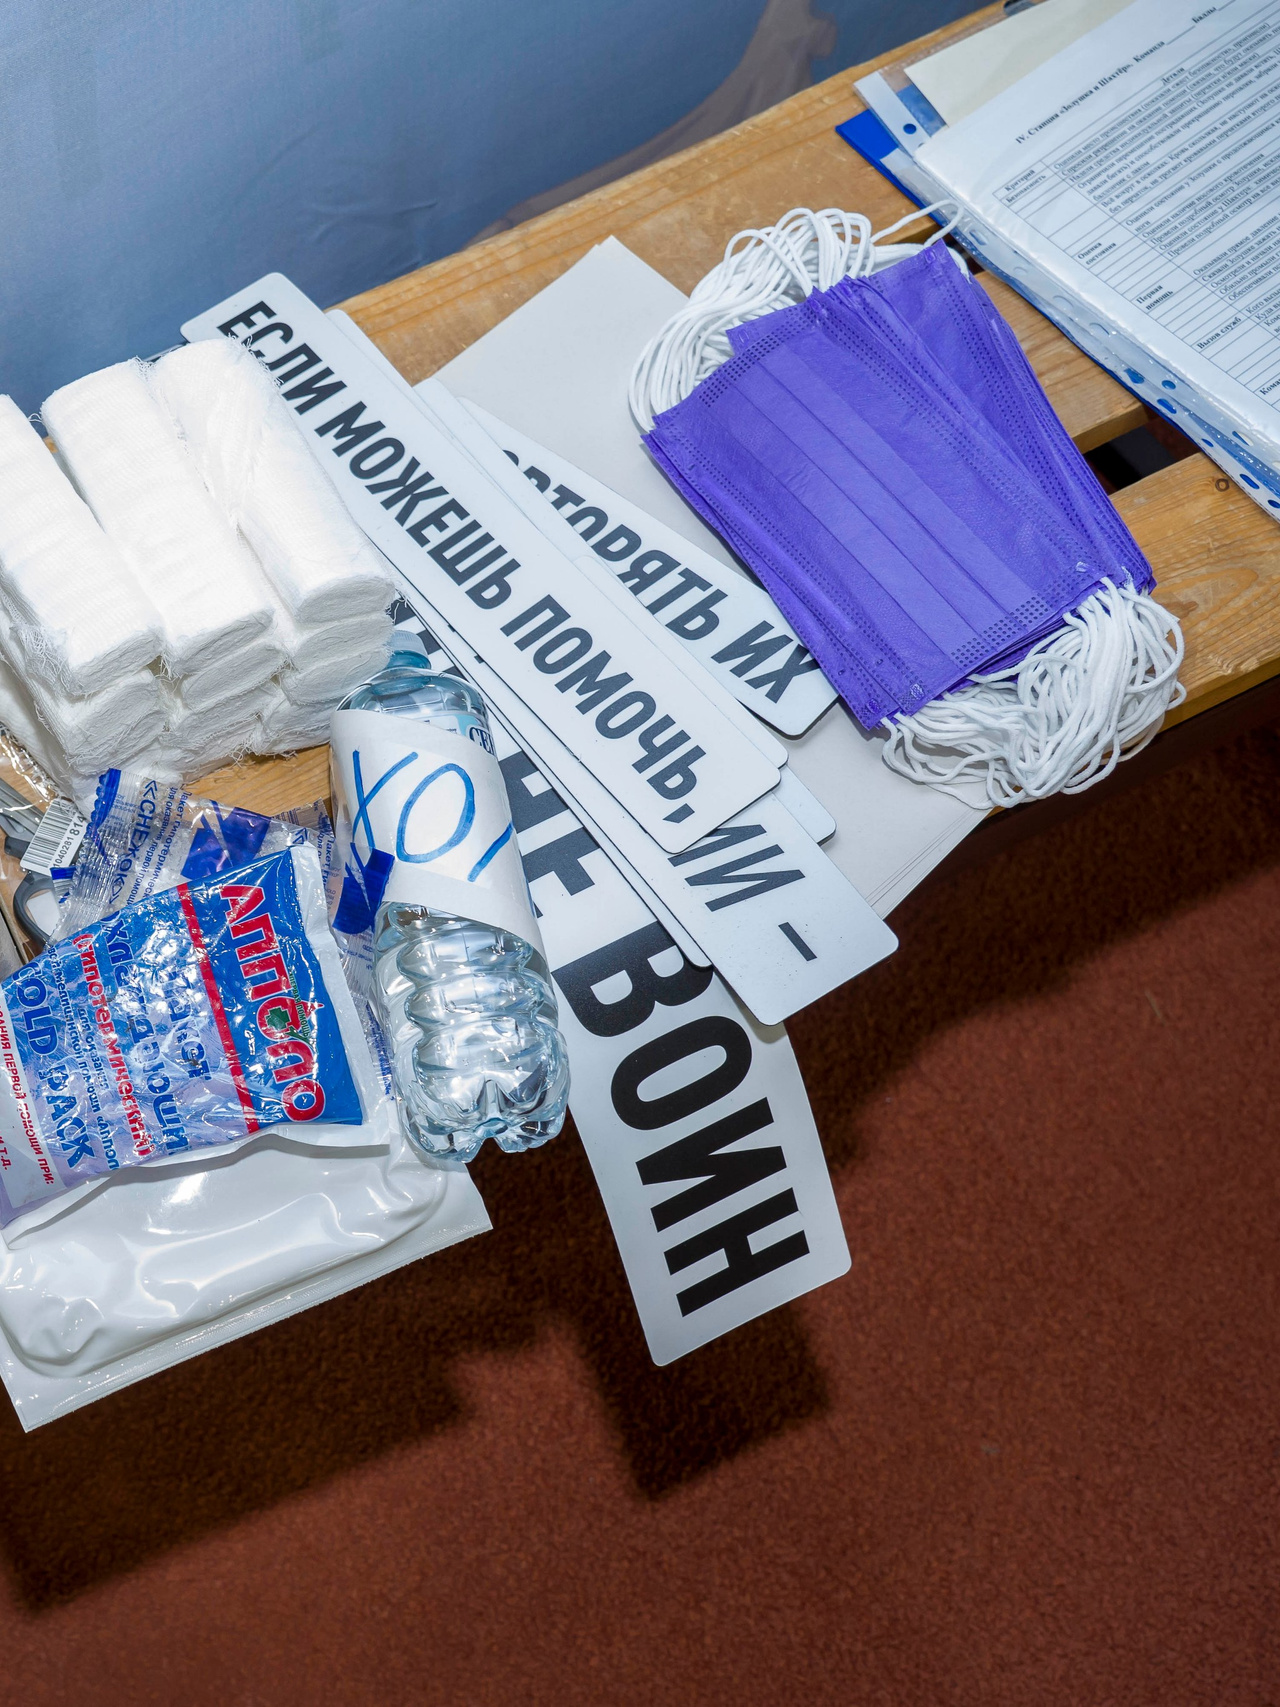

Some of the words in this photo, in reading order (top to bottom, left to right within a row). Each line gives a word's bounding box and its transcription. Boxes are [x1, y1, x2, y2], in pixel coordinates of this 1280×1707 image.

[1160, 65, 1185, 85] Детали
[1015, 132, 1029, 144] IV.
[1027, 112, 1060, 136] Станция
[1004, 168, 1036, 192] Критерий
[1005, 173, 1046, 203] Безопасность
[1077, 240, 1102, 260] Оценка
[1084, 241, 1116, 265] состояния
[1136, 283, 1163, 305] Первая
[1145, 288, 1174, 311] помощь
[1196, 329, 1221, 350] Вызов
[1218, 315, 1242, 335] служб
[217, 300, 347, 416] ЕСЛИ
[317, 402, 521, 610] МОЖЕШЬ
[500, 594, 707, 825] ПОМОЧЬ,
[711, 620, 823, 705] ИХ
[6, 960, 65, 1057] COLD
[37, 1063, 97, 1169] PACK
[2, 1051, 26, 1100] ПЕРВОЙ
[37, 1156, 55, 1185] ПРИ:
[552, 922, 811, 1317] ВОИН
